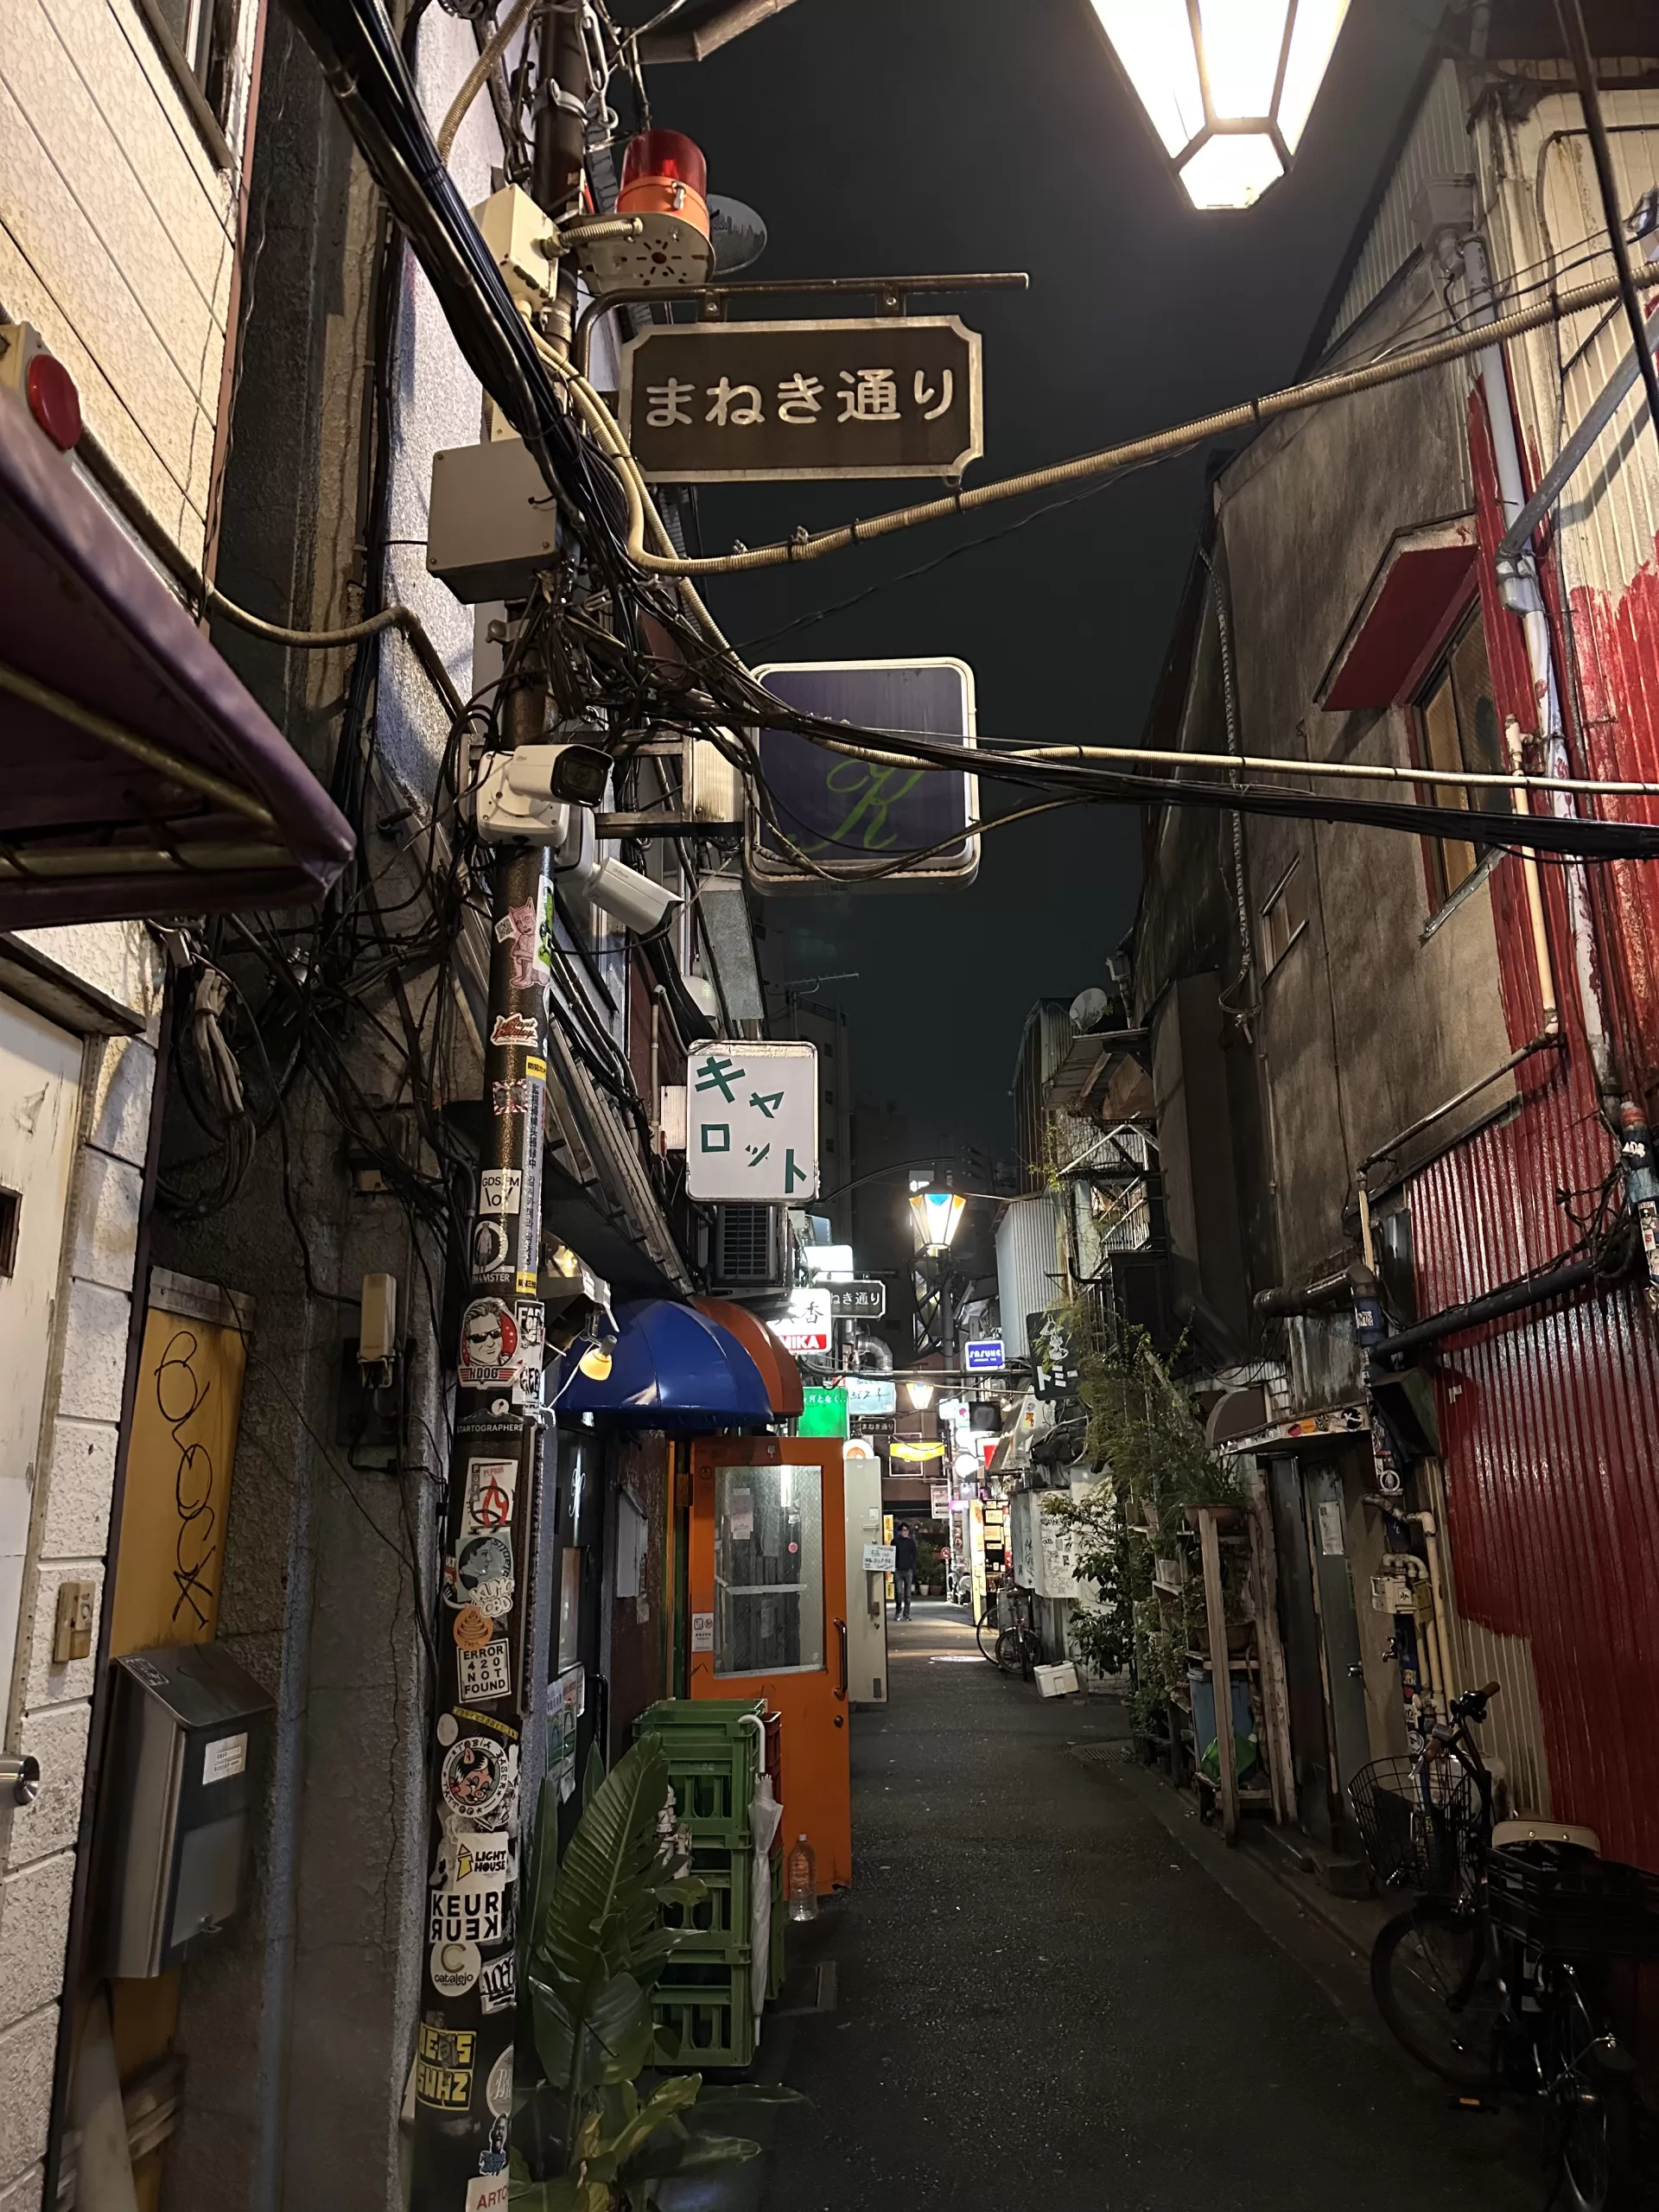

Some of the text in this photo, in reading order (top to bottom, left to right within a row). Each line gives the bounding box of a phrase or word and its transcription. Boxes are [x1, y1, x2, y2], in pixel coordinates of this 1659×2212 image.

[645, 368, 954, 427] まねき通り
[469, 1369, 499, 1379] KDOG
[456, 1423, 524, 1433] STARTOGRAPHERS
[481, 1596, 512, 1617] CBD
[463, 1645, 504, 1661] ERROR
[467, 1669, 502, 1682] NOT
[464, 1679, 505, 1695] FOUND
[442, 1782, 474, 1815] TATTOO
[475, 1850, 506, 1862] LIGHT
[474, 1860, 505, 1872] HOUSE
[432, 1891, 499, 1917] KEUR
[434, 1972, 474, 1986] catalejo
